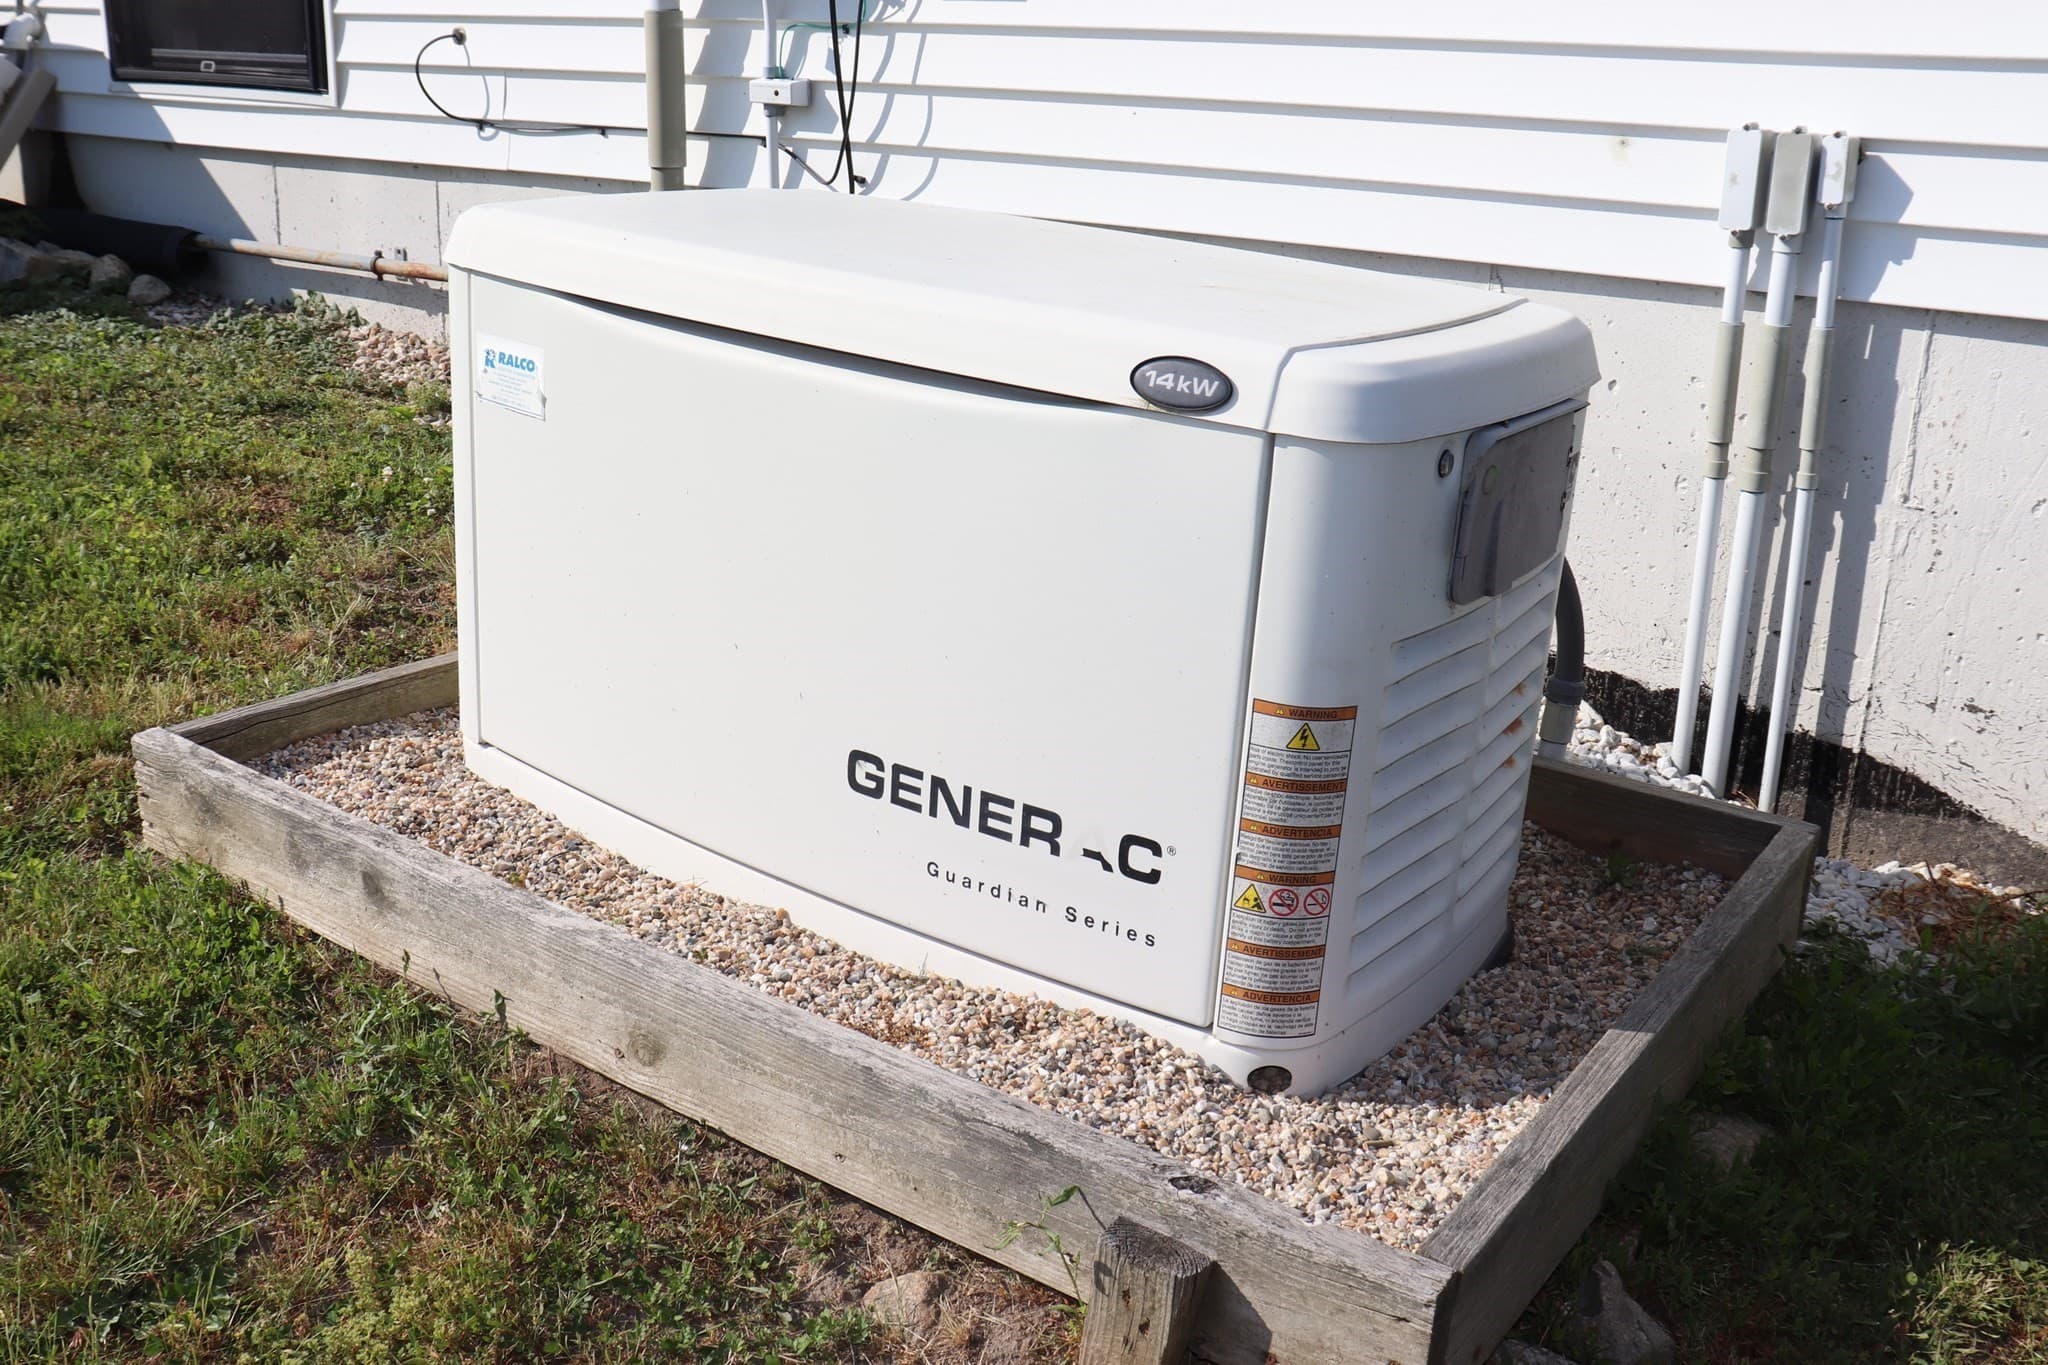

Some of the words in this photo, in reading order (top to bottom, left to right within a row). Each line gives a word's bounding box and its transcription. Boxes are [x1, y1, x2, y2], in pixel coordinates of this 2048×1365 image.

[498, 352, 535, 372] RALCO
[1145, 370, 1220, 398] 14kW
[1289, 709, 1337, 719] WARNING
[1262, 779, 1345, 792] AVERTISSEMENT
[1262, 826, 1332, 837] ADVERTENCIA
[1268, 873, 1317, 884] WARNING
[926, 861, 1048, 914] Guardian
[1065, 907, 1157, 948] Series
[1243, 945, 1322, 958] AVERTISSEMENT
[1243, 991, 1311, 1003] ADVERTENCIA
